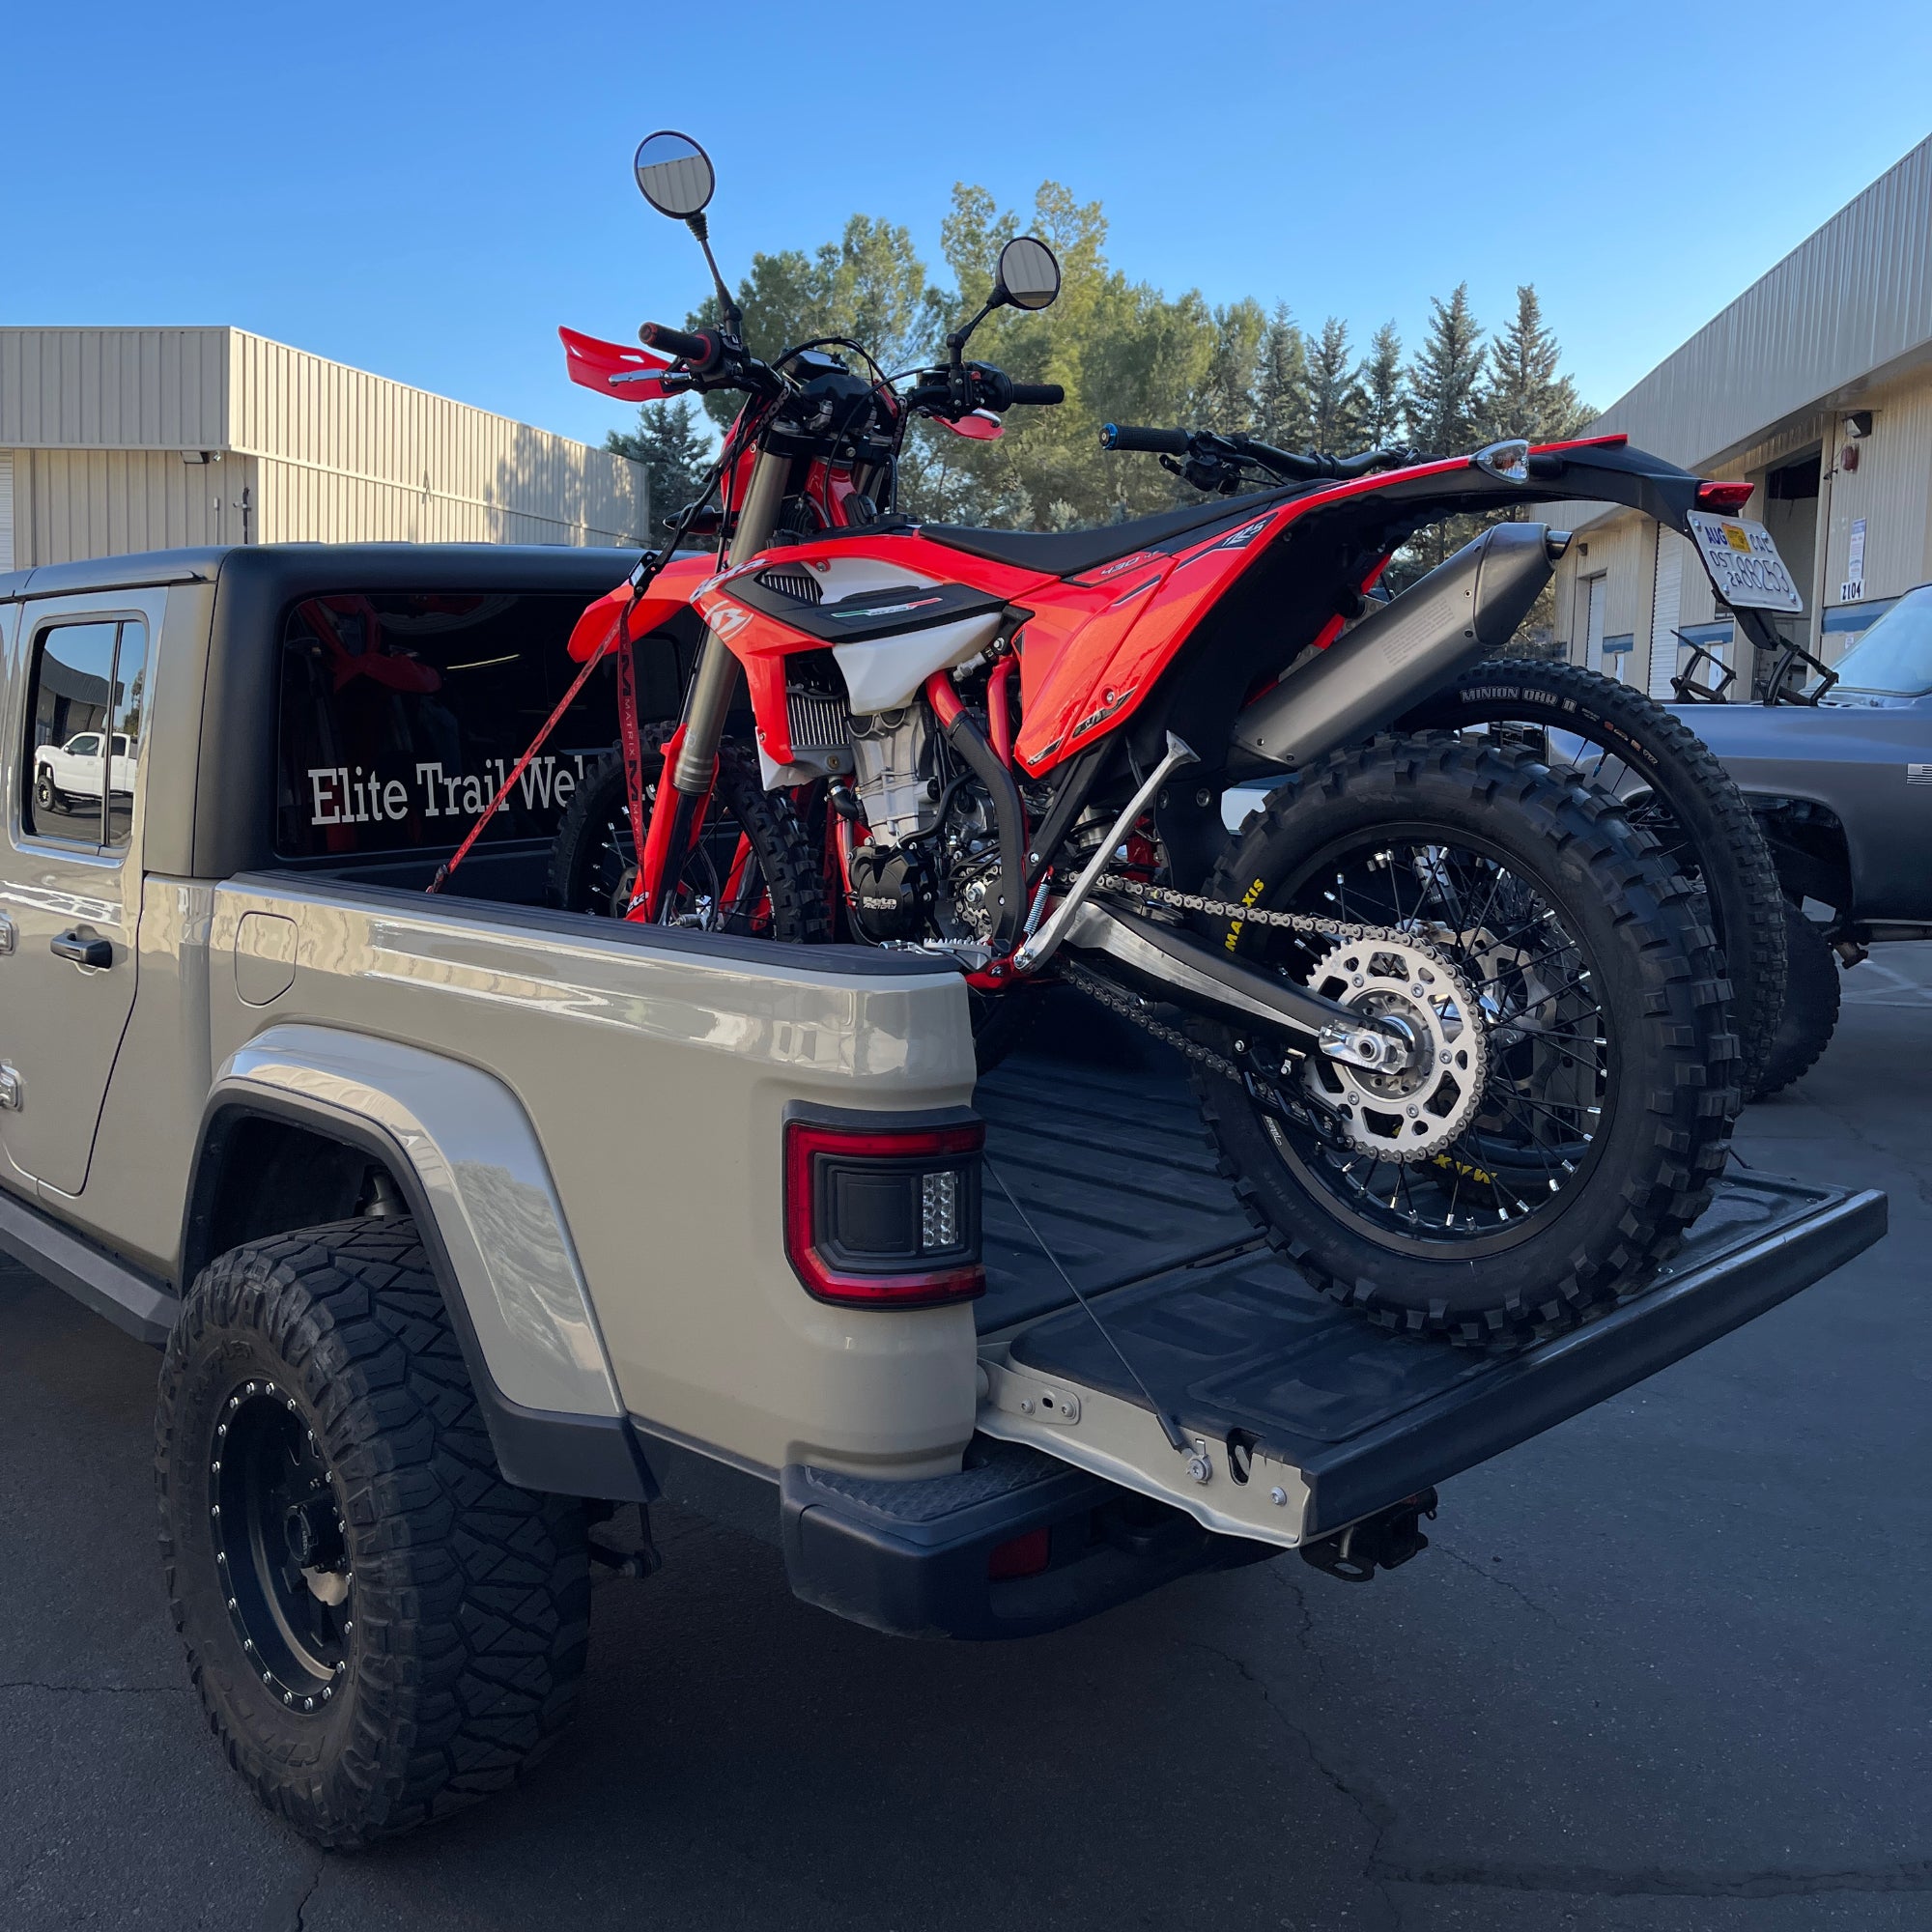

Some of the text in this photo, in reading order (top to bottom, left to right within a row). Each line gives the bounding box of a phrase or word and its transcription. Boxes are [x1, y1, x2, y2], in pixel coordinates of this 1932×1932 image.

[1704, 526, 1728, 546] AUG
[1747, 533, 1774, 554] CAL
[1735, 555, 1790, 593] 88253
[1841, 582, 1861, 601] 2104
[1461, 686, 1520, 703] MINION
[624, 698, 636, 756] MATRIX
[308, 766, 409, 826] Elite
[416, 758, 510, 817] Trail
[627, 890, 650, 913] eta
[864, 896, 896, 905] Beta
[1224, 877, 1265, 953] MAXIS
[1432, 1153, 1498, 1184] MAX
